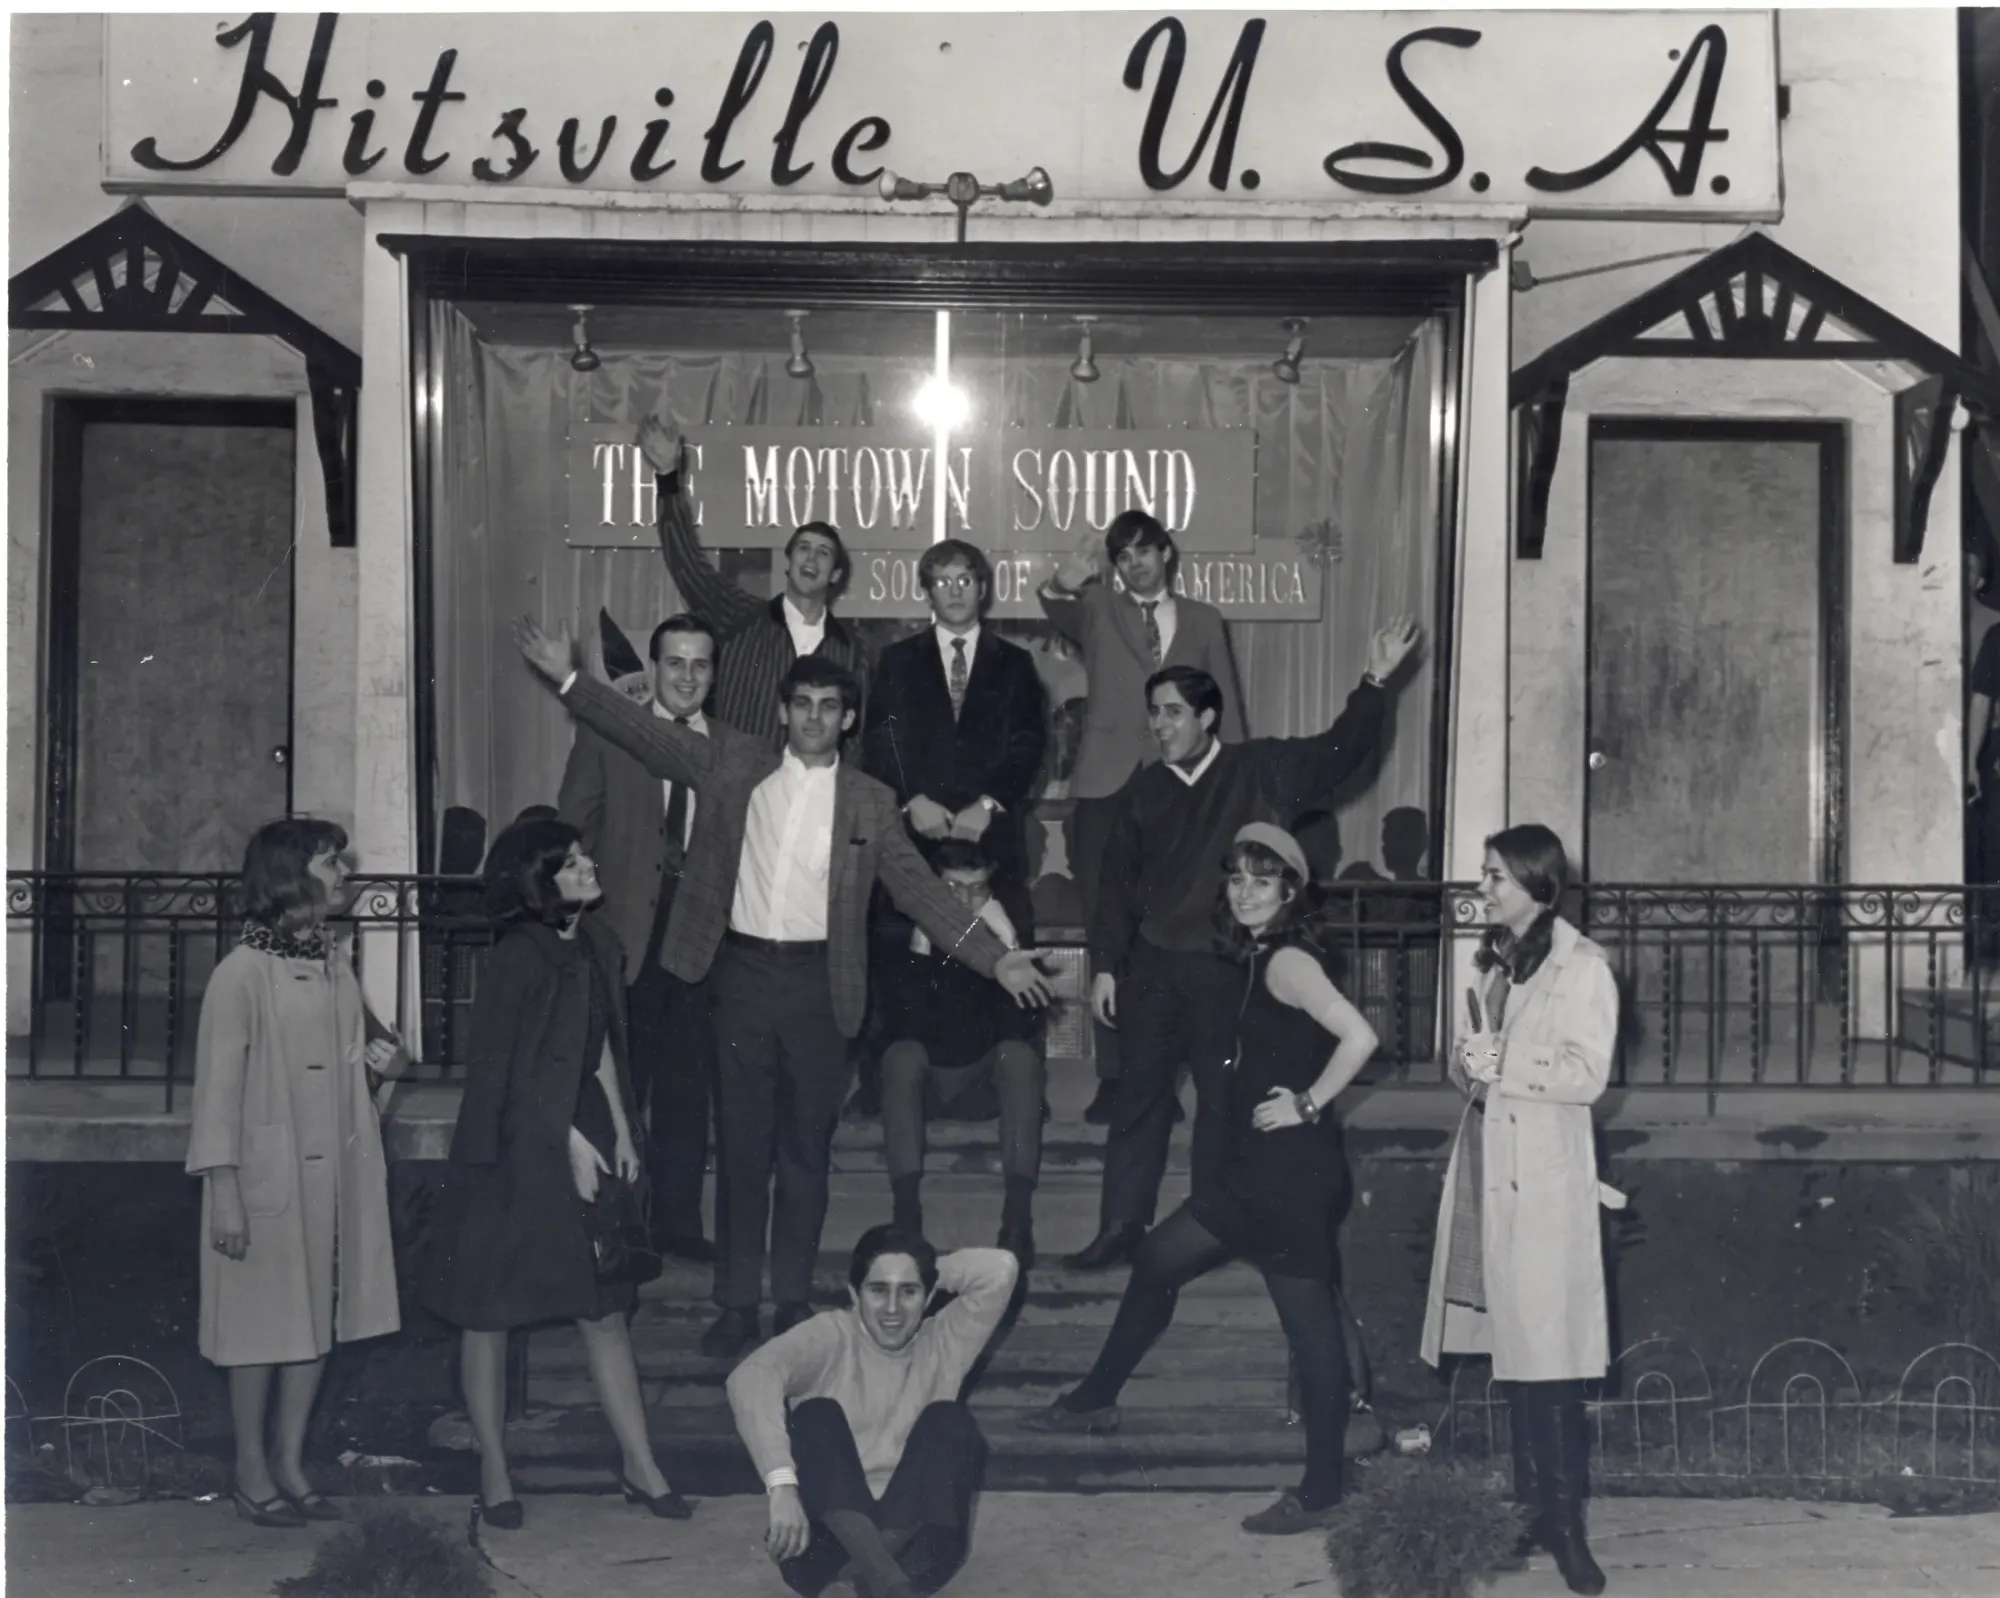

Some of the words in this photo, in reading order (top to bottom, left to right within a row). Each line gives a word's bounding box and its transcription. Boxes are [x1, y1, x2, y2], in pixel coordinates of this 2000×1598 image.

[130, 12, 892, 184] Hitsville
[1122, 16, 1267, 192] U.
[1324, 26, 1491, 193] S.
[1525, 23, 1731, 196] A.
[743, 445, 973, 531] MOTOWN
[1012, 447, 1197, 533] SOUND
[869, 558, 926, 601] SOU
[994, 559, 1032, 602] OF
[1173, 561, 1305, 604] AMERICA
